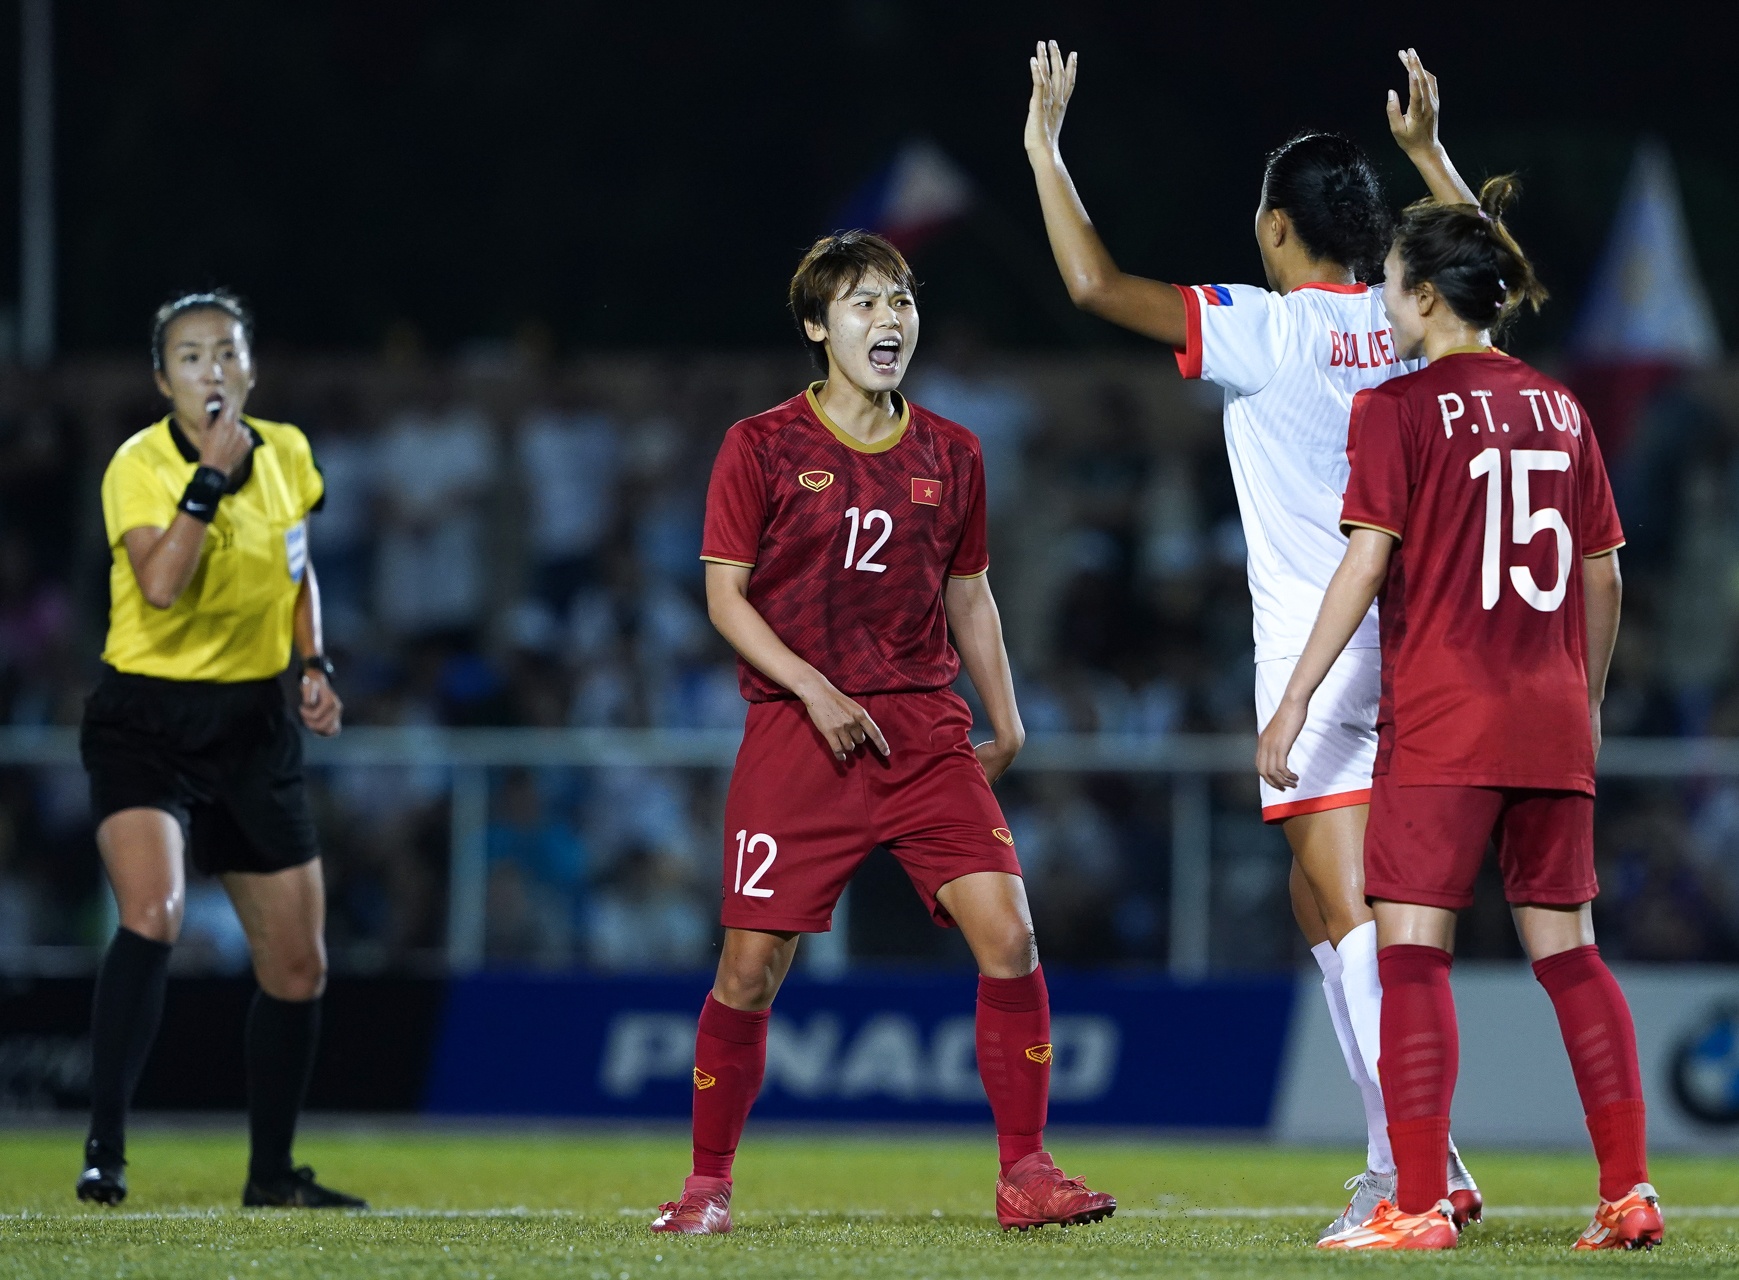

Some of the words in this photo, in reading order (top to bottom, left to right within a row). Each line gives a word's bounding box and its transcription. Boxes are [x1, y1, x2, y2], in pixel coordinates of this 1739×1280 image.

[1437, 389, 1510, 439] P.T.
[844, 506, 893, 573] 12
[1469, 447, 1573, 612] 15
[734, 829, 778, 898] 12
[603, 1012, 1118, 1102] PNACO
